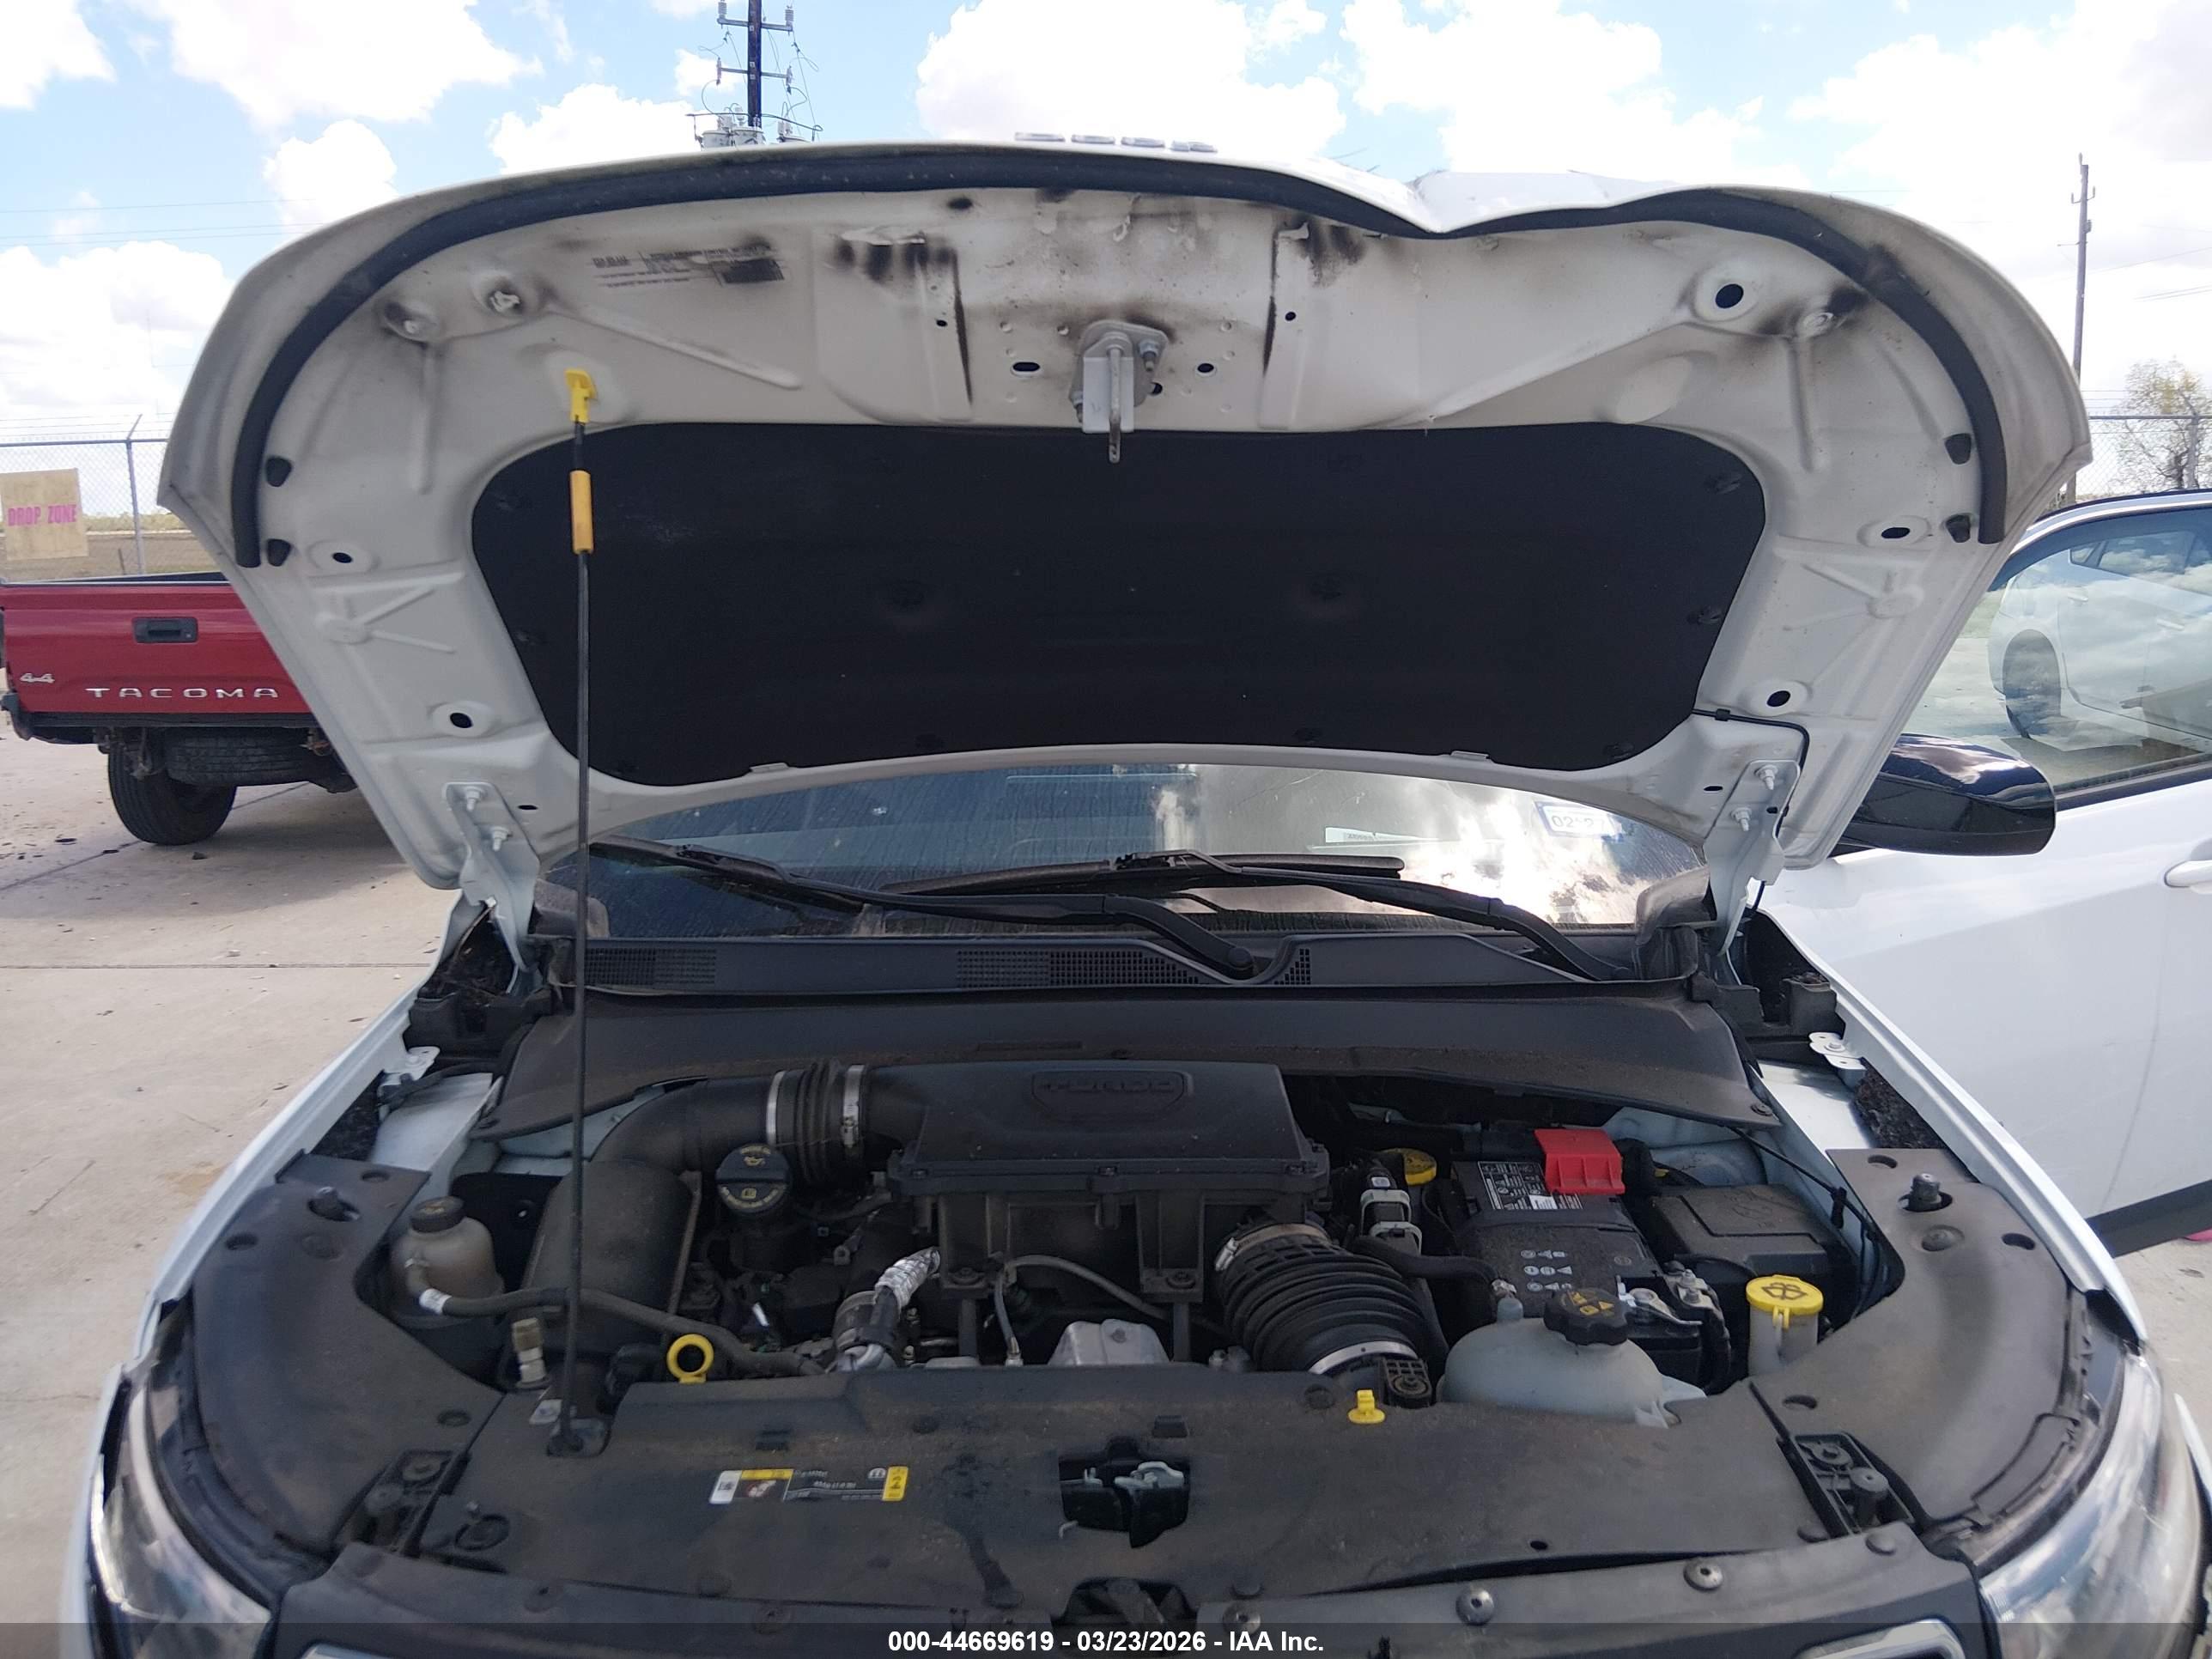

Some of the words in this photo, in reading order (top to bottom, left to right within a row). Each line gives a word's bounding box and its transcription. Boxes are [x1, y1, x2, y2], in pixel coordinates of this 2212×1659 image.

[8, 506, 41, 526] DROP
[47, 504, 76, 524] ZONE
[86, 688, 278, 698] TACOMA
